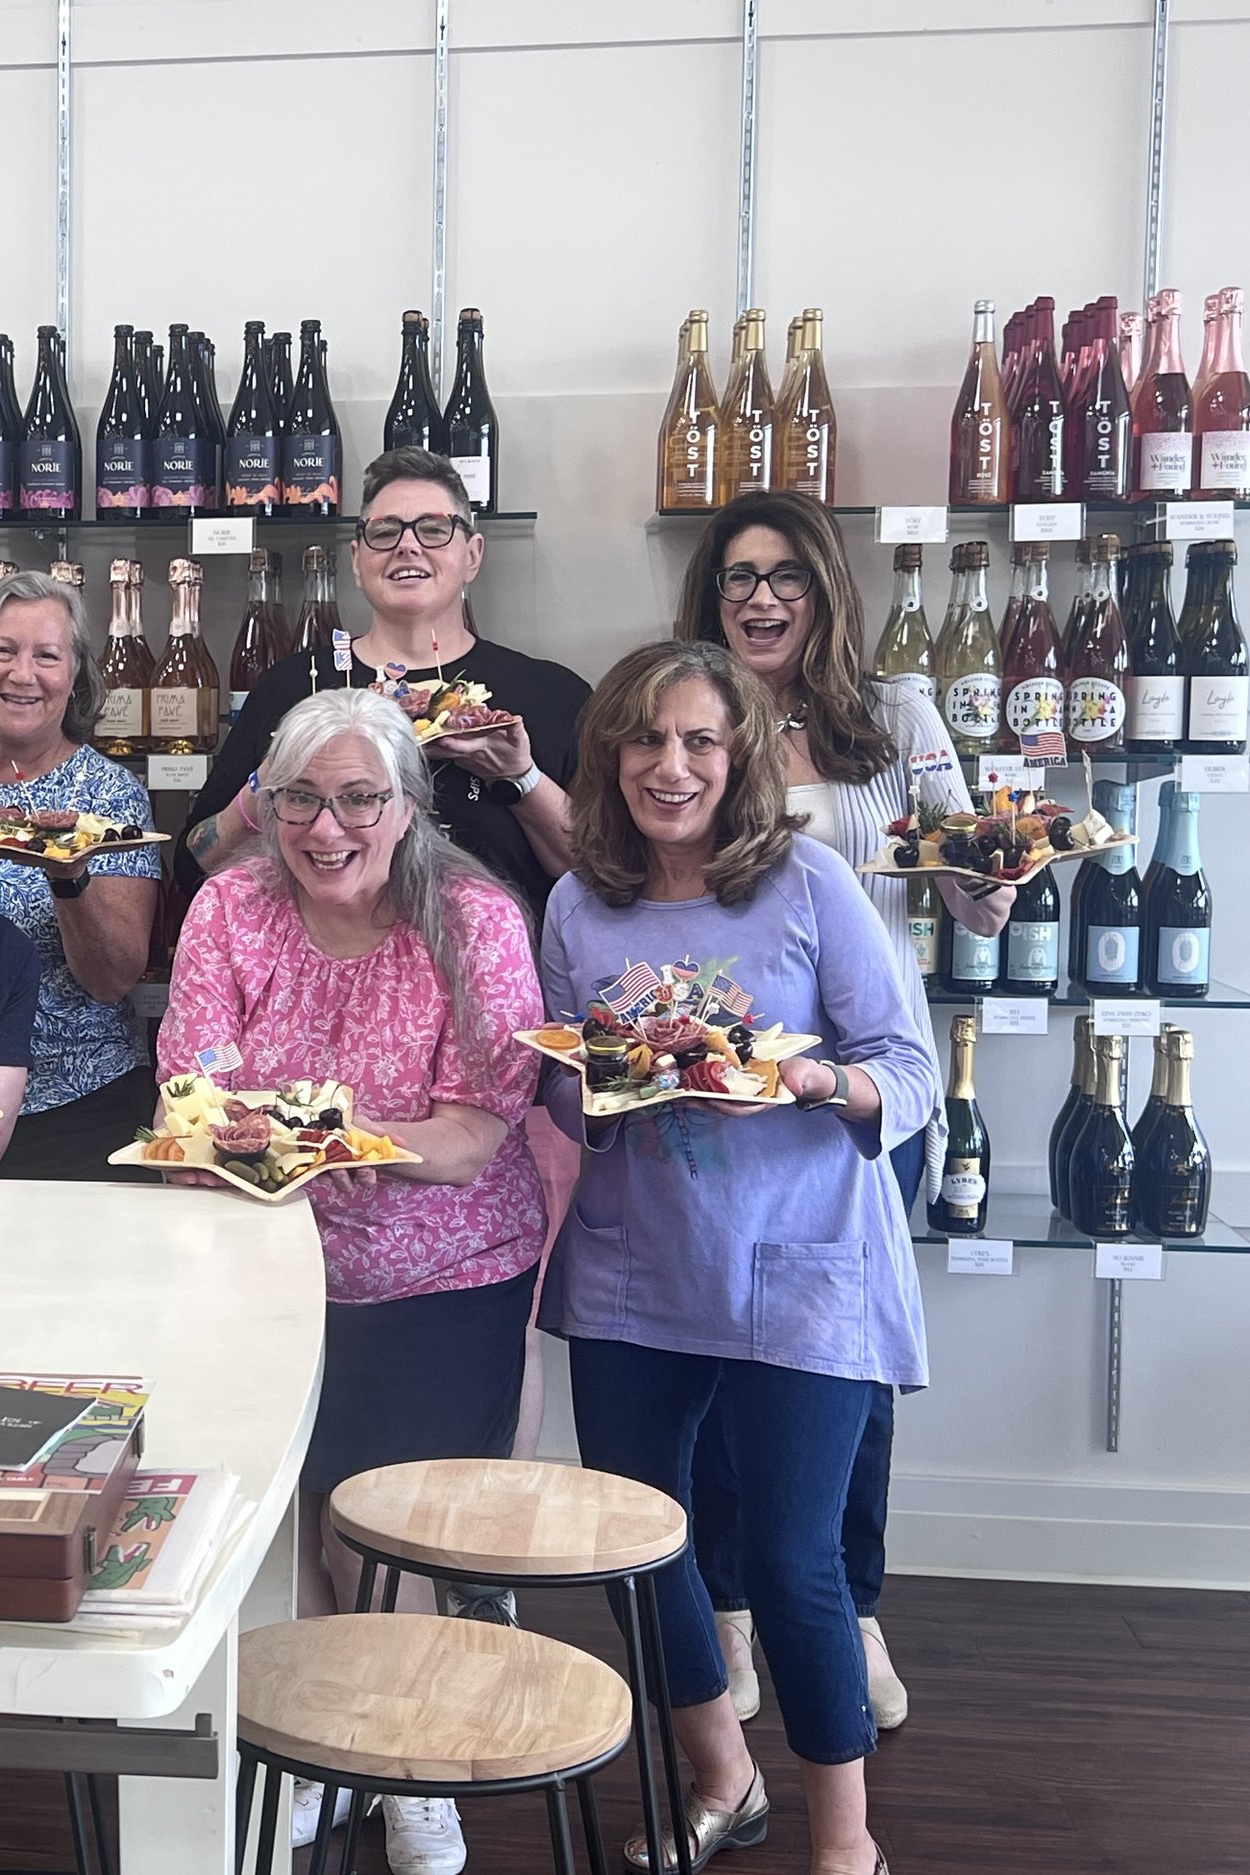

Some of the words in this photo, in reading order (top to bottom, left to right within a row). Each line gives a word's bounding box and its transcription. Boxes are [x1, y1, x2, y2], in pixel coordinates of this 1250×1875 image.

[978, 402, 993, 470] TÖST
[1096, 400, 1112, 468] TÖST
[686, 411, 701, 477] TÖST
[749, 409, 764, 476] TÖST
[806, 409, 821, 476] TÖST
[31, 462, 61, 473] NORIE
[104, 460, 134, 471] NORIE
[163, 460, 194, 471] NORIE
[239, 458, 270, 468] NORIE
[293, 457, 324, 467] NORIE
[156, 694, 186, 705] PRIMA
[1014, 691, 1064, 702] SPRING
[1013, 704, 1028, 714] IN
[1023, 756, 1066, 768] AMERICA
[908, 922, 934, 936] ISH
